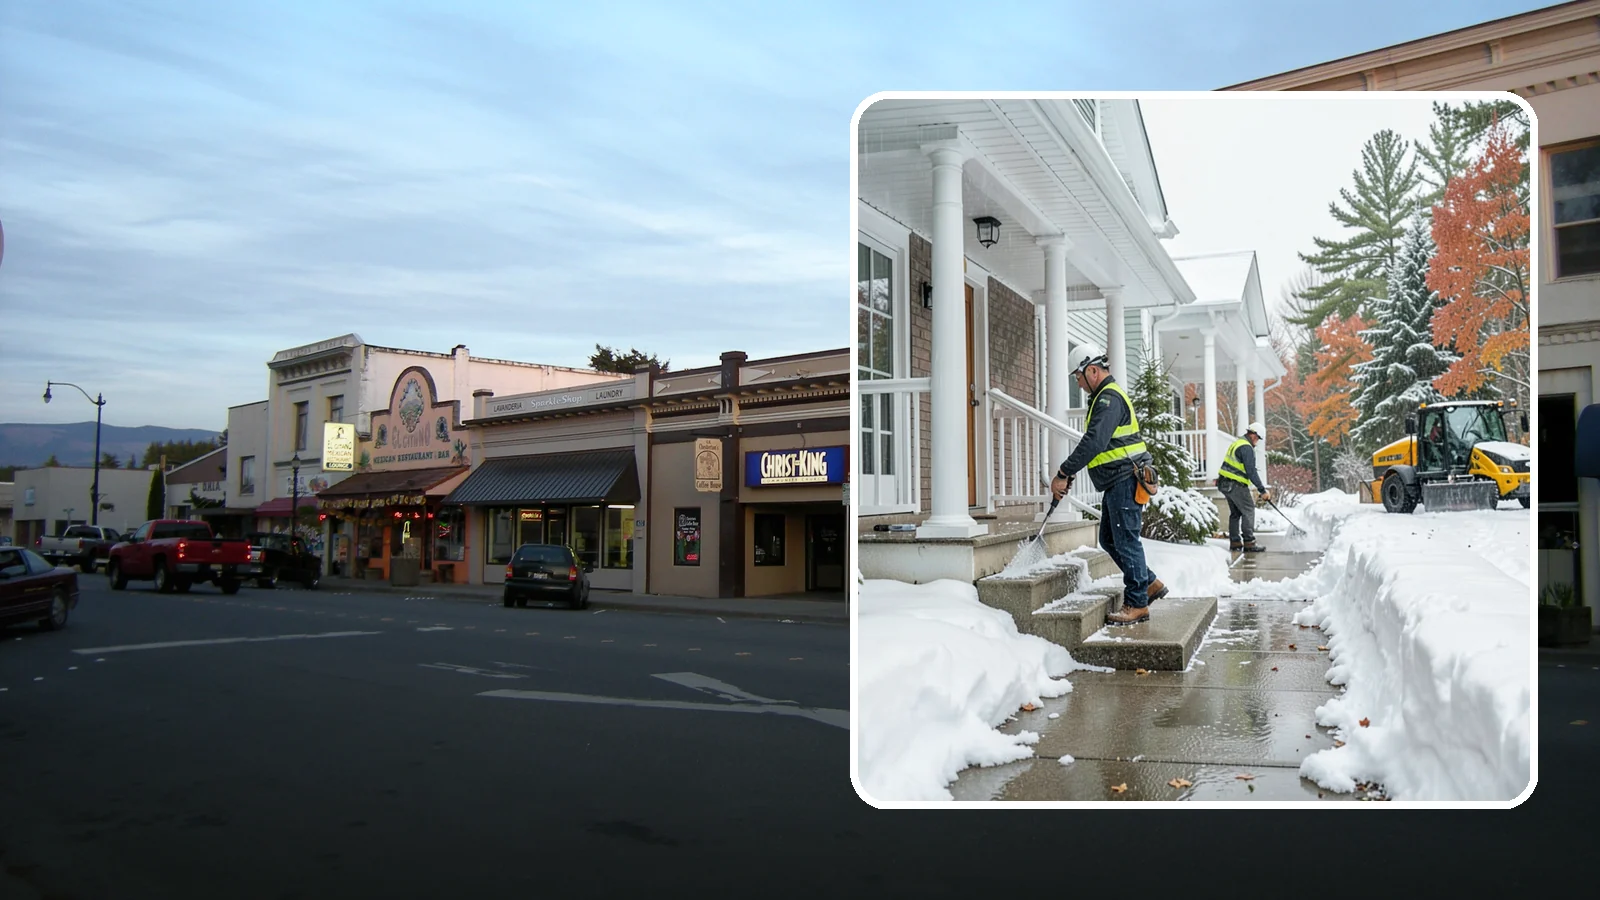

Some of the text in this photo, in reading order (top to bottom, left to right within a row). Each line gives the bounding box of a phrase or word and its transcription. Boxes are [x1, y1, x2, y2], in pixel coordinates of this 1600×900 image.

[561, 394, 582, 404] Shop
[595, 389, 624, 400] LAUNDRY
[494, 402, 523, 413] LAVANDERIA
[373, 450, 450, 464] MEXICAN RESTAURANT BAR
[761, 450, 827, 478] CHRIST KING
